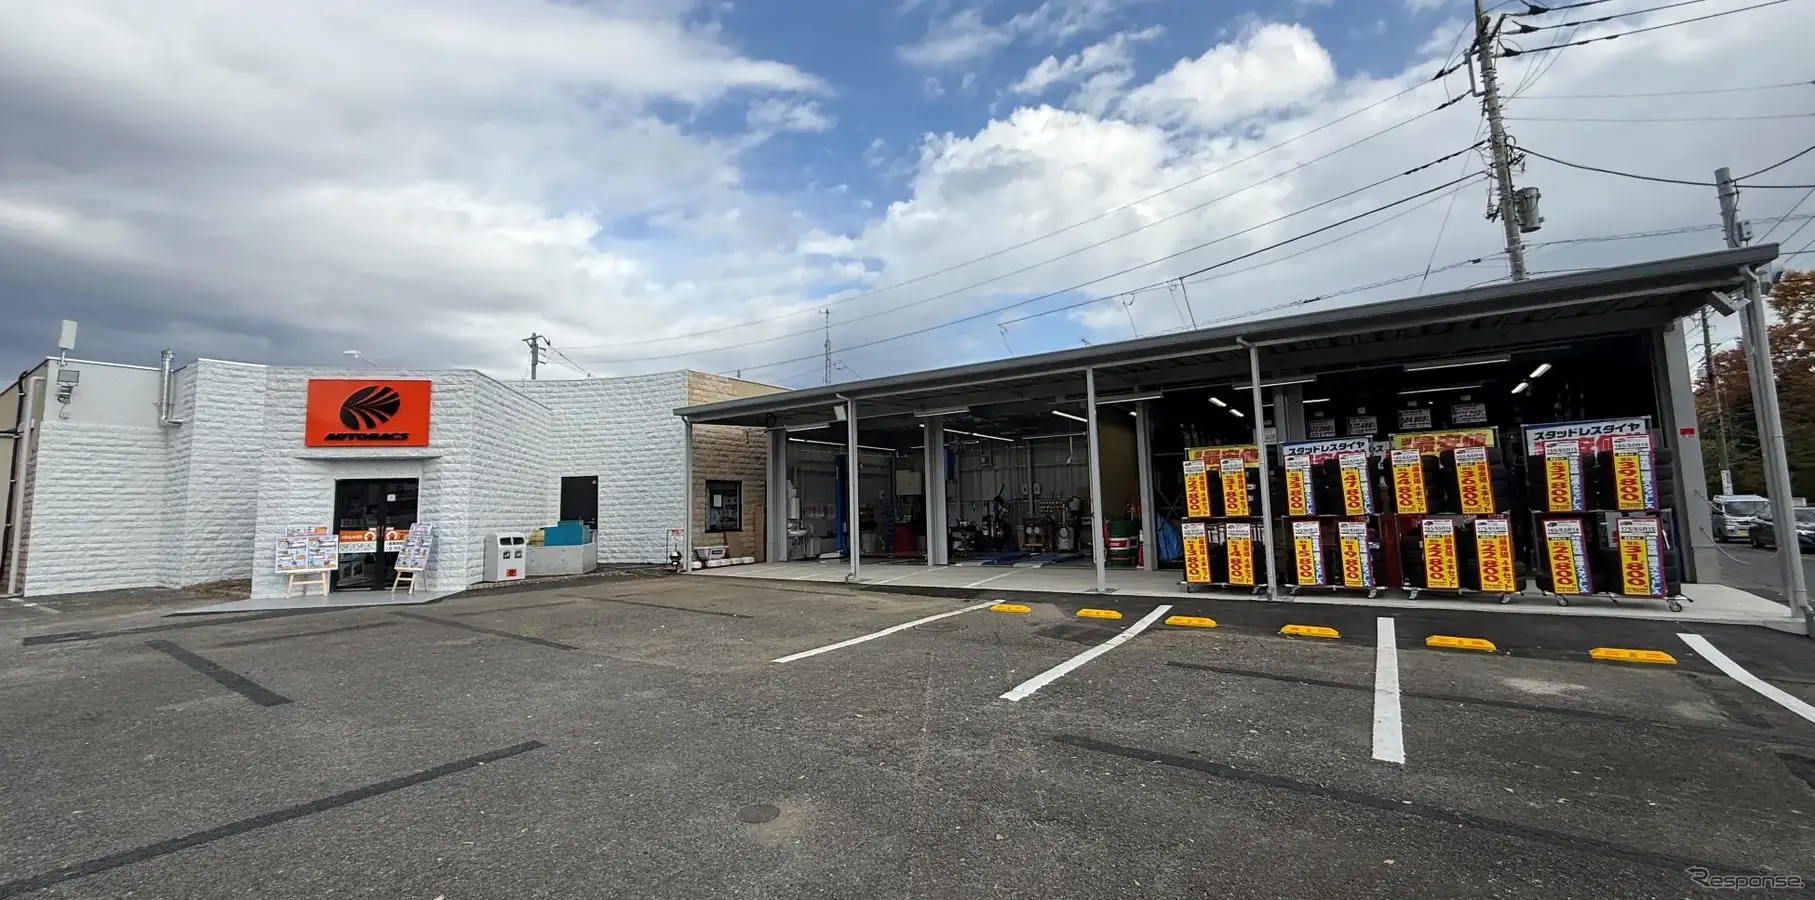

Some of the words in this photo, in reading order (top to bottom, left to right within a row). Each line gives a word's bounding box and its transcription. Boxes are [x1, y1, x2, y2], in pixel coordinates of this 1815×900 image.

[323, 432, 410, 441] AUTOBACS
[1534, 422, 1641, 440] スタッドレスタイヤ
[1288, 441, 1366, 455] スタッドレスタイヤ
